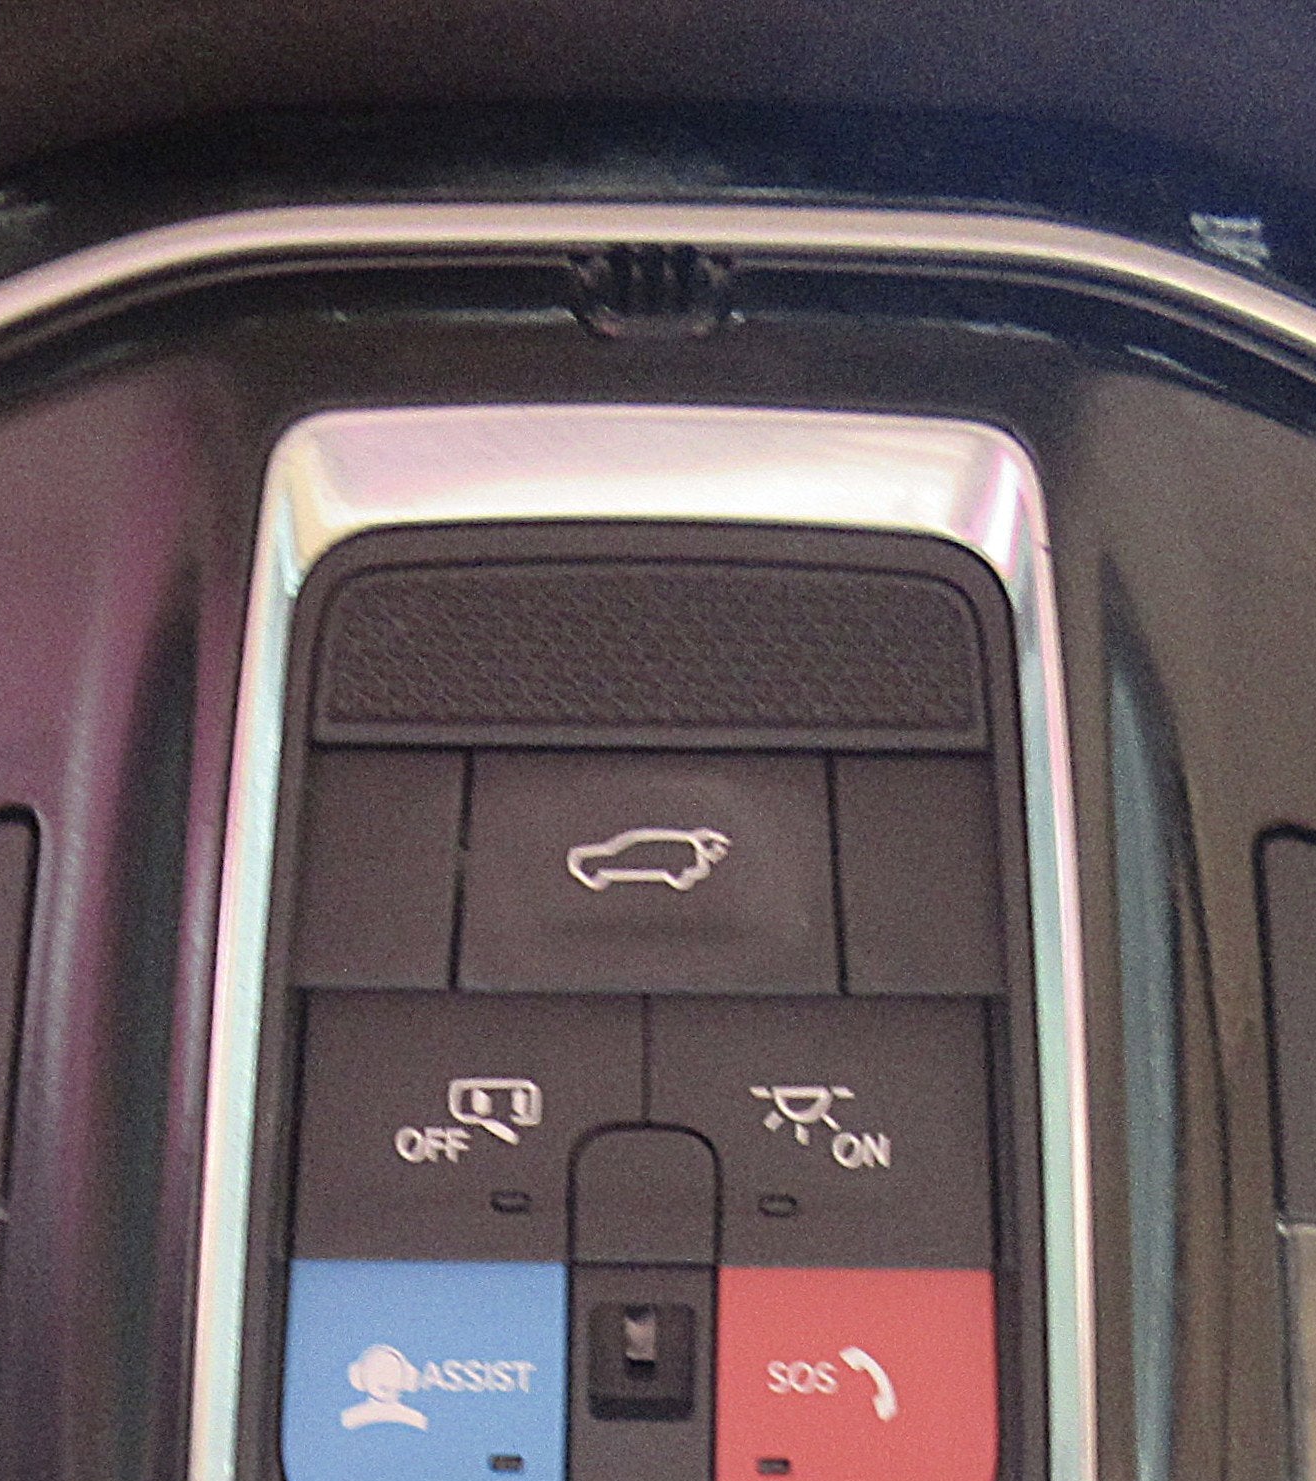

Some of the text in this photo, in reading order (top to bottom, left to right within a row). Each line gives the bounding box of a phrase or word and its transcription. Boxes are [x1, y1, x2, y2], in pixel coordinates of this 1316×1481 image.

[395, 1126, 470, 1163] OFF
[832, 1132, 891, 1168] ON
[420, 1360, 537, 1394] ASSIST
[768, 1360, 837, 1394] SOS
